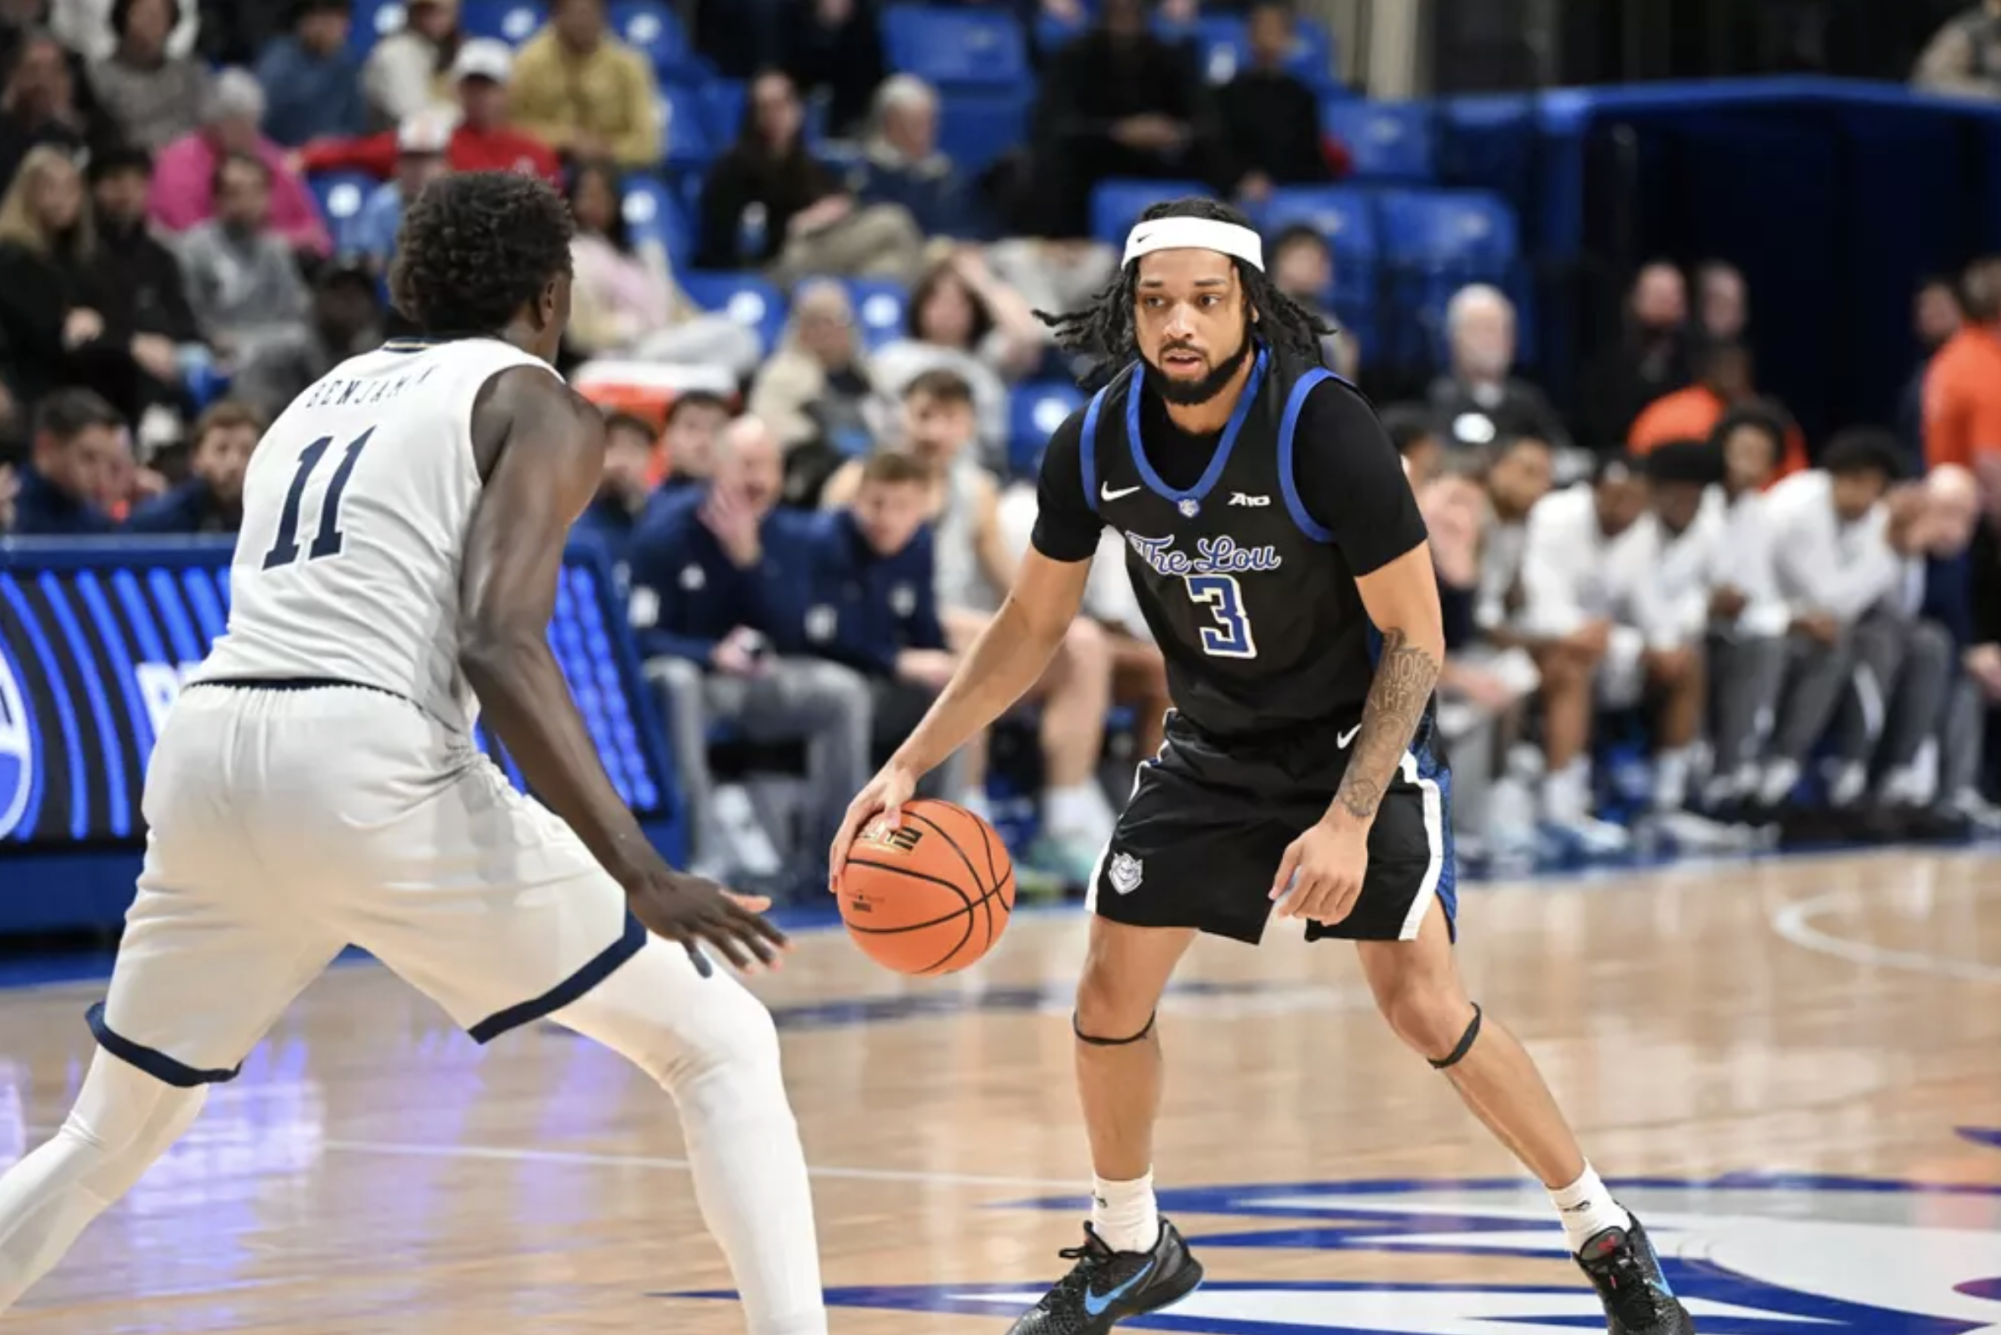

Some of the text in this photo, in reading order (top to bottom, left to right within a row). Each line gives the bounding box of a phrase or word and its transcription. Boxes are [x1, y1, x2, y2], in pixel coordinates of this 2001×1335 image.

[261, 424, 377, 571] 11
[1124, 529, 1282, 574] The Lou
[1183, 572, 1257, 659] 3
